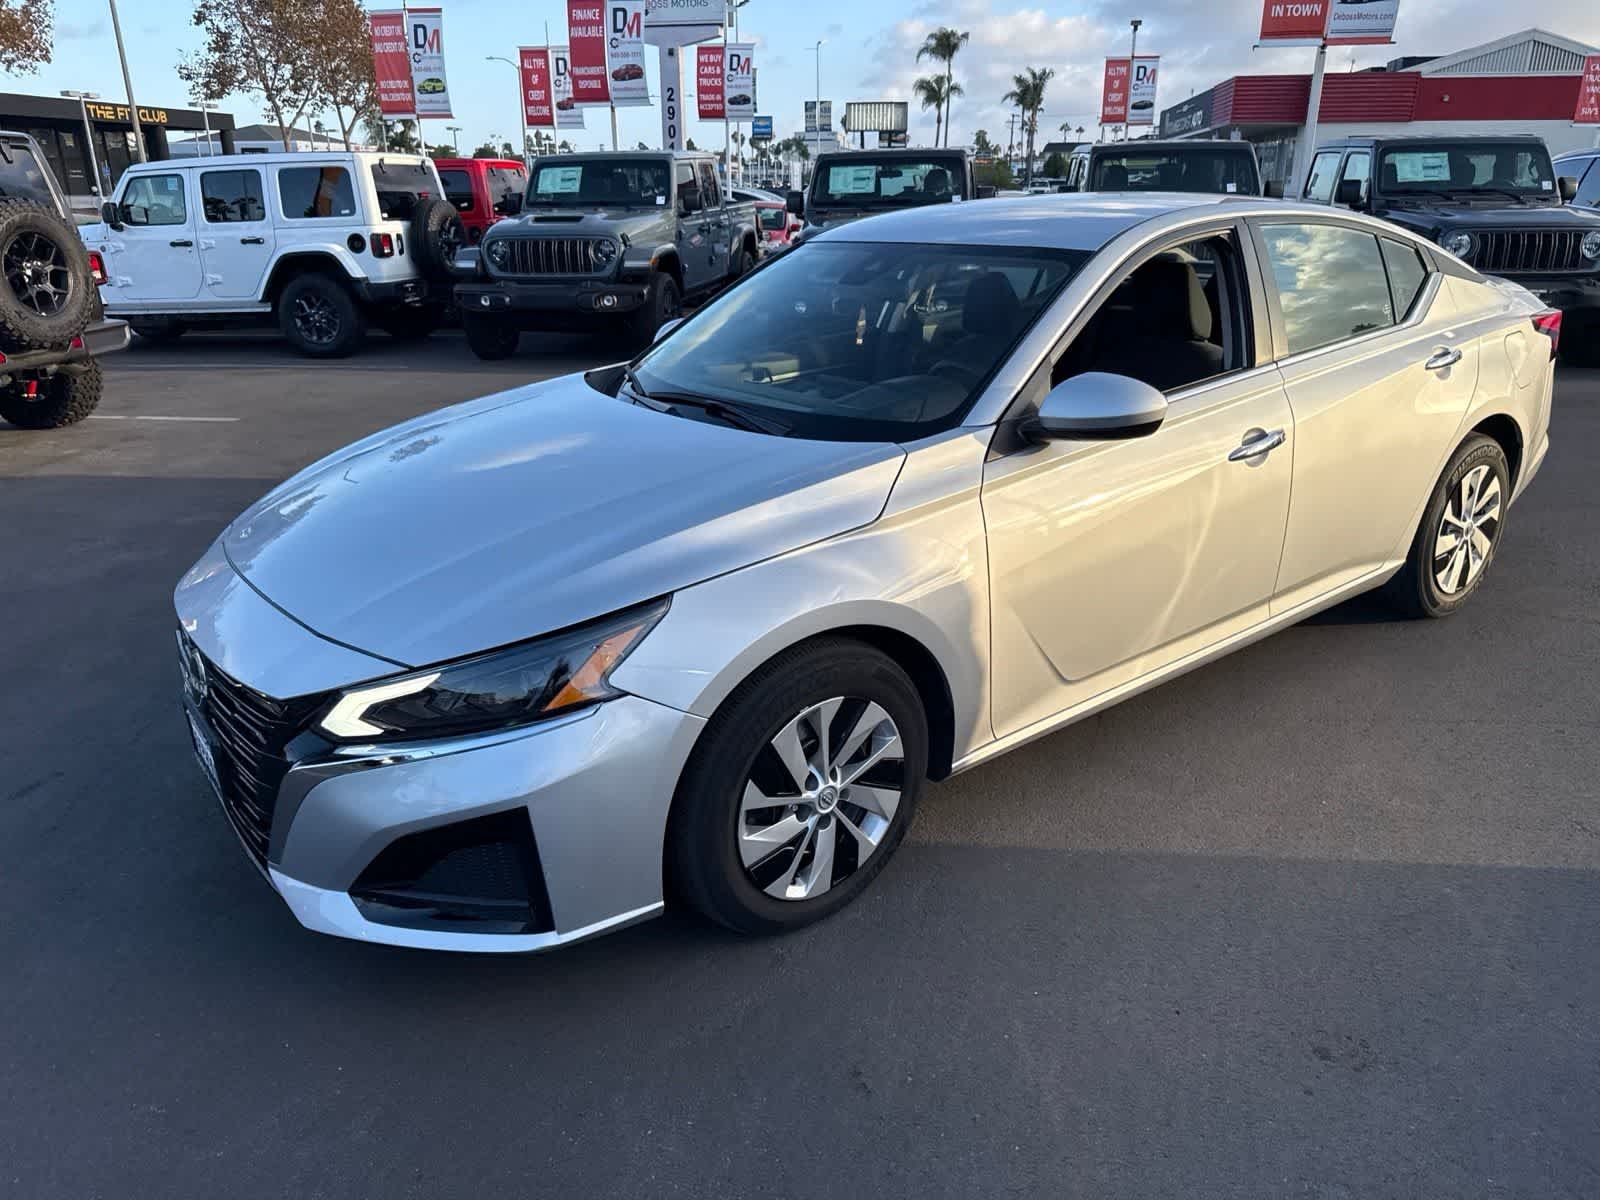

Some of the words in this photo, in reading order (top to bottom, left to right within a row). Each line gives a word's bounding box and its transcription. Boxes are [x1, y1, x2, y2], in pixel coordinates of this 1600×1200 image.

[671, 0, 709, 8] MOTORS
[572, 9, 600, 20] FINANCE
[1271, 5, 1284, 17] IN
[1286, 4, 1321, 16] TOWN
[570, 25, 603, 38] AVAILABLE
[532, 58, 545, 69] TYPE
[699, 54, 708, 63] WE
[709, 54, 722, 64] BUY
[699, 65, 715, 75] CARS
[699, 78, 722, 87] TRUCKS
[86, 104, 116, 120] THE
[117, 107, 131, 121] FI
[138, 109, 168, 123] CLUB
